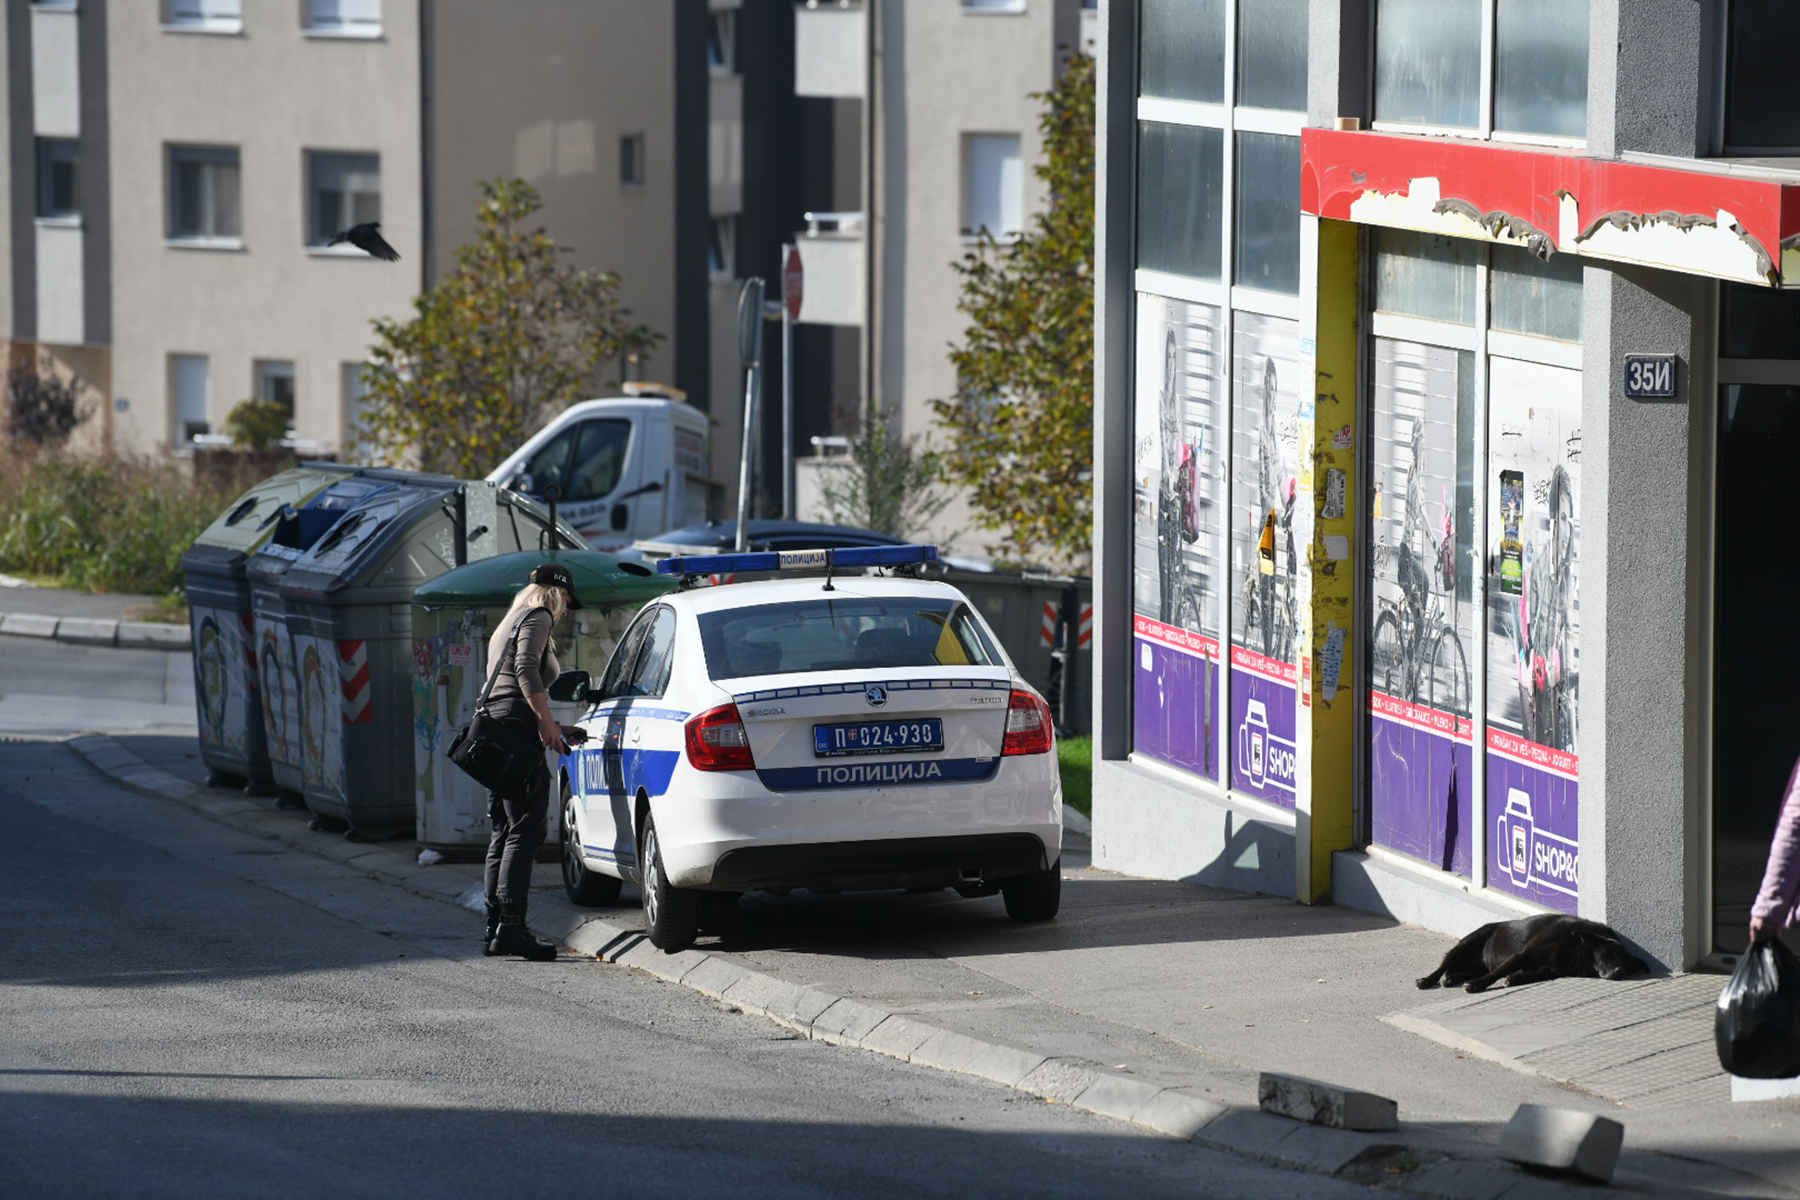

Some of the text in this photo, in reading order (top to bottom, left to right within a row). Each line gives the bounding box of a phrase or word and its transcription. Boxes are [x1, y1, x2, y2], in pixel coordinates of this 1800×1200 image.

[1630, 361, 1670, 391] 35И
[781, 553, 825, 564] ПОЛИЦИЈА
[835, 728, 846, 747] П
[1512, 741, 1518, 752] ZA
[817, 762, 942, 783] ПОЛИЦИЈА
